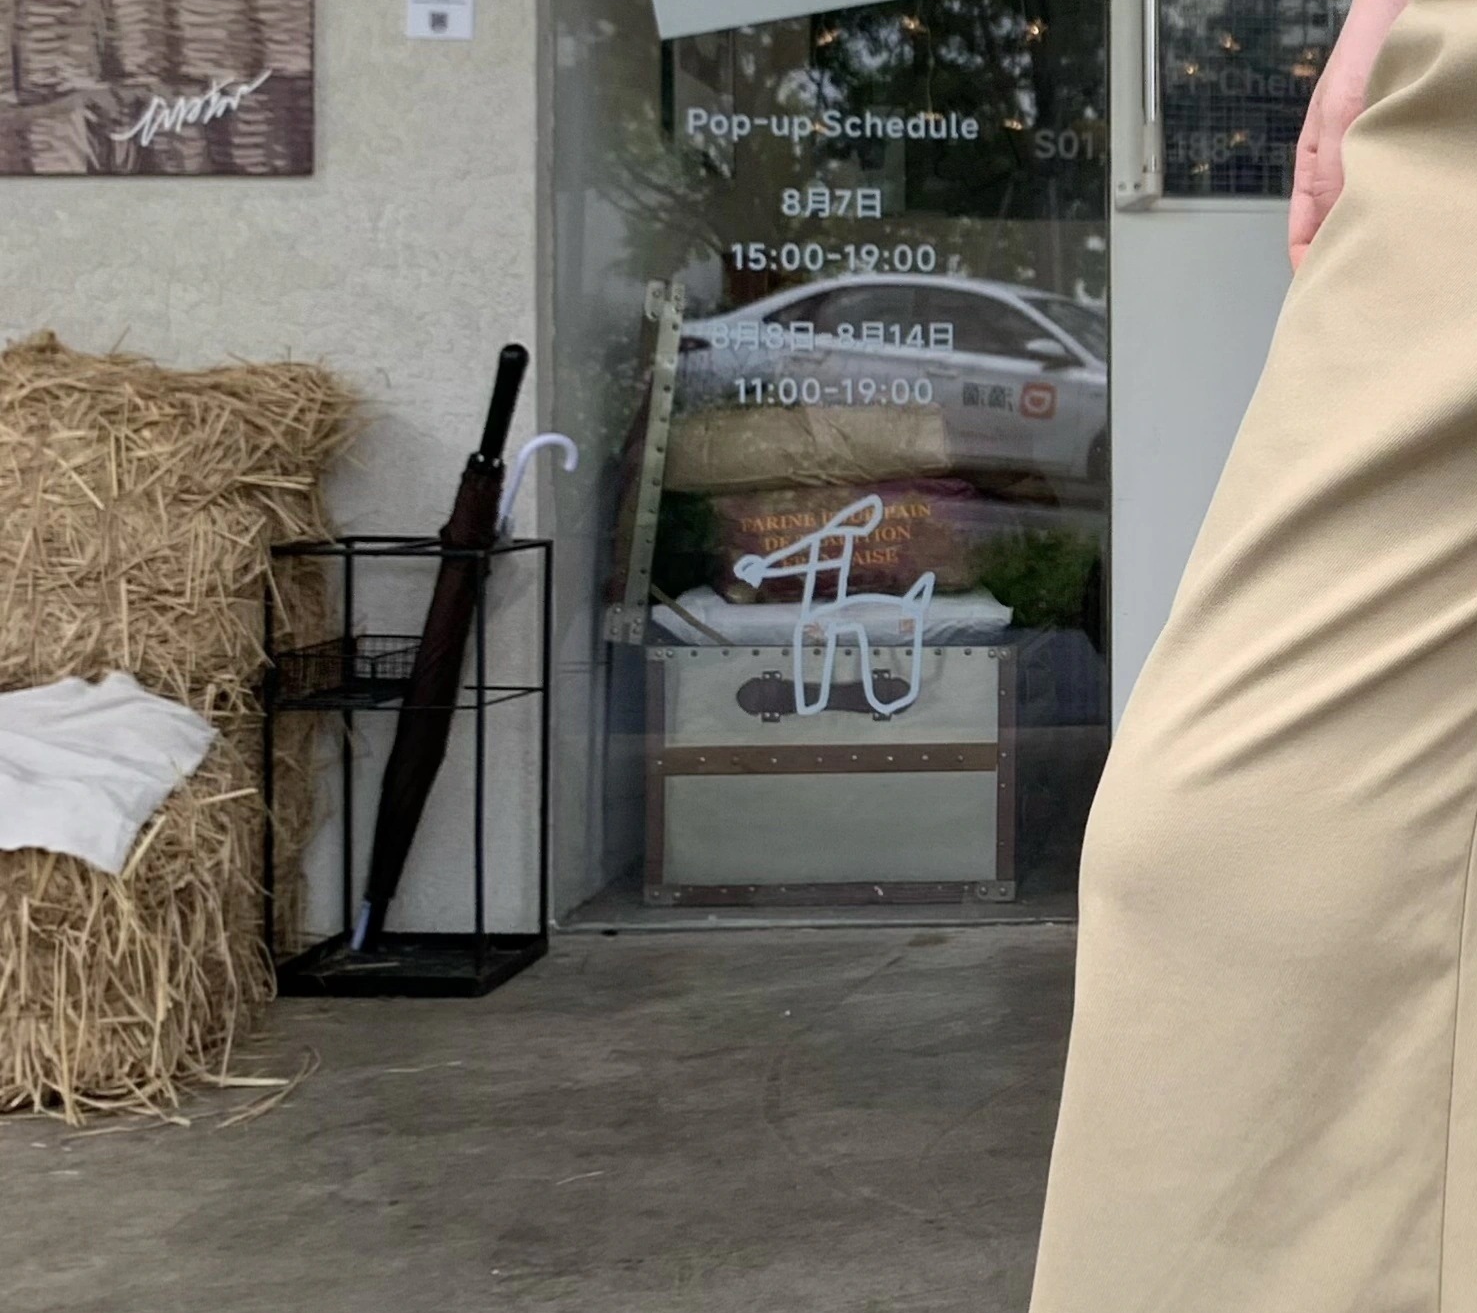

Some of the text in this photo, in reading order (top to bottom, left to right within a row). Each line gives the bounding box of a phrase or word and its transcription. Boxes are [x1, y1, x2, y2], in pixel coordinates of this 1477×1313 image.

[685, 108, 979, 141] Pop-up Schedule
[781, 186, 881, 218] 8月7日
[730, 242, 937, 273] 15:00-19:00
[734, 377, 934, 406] 11:00-19:00
